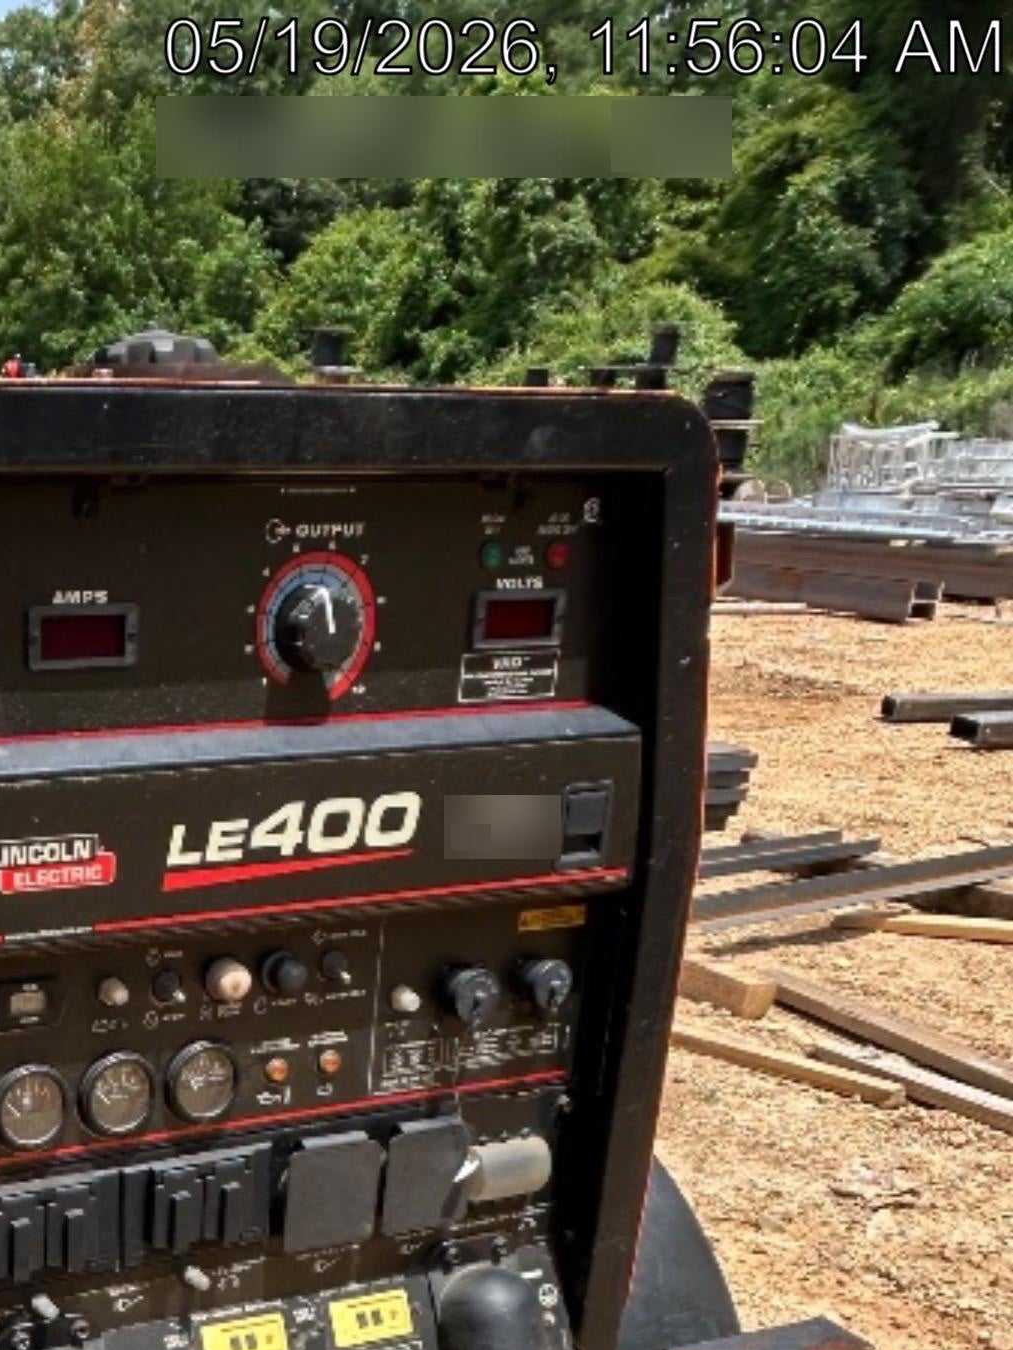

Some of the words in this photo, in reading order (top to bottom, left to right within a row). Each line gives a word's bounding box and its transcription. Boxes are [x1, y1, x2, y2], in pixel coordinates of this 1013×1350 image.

[295, 522, 366, 538] OUTPUT
[496, 575, 544, 590] VOLTS
[52, 589, 108, 604] AMPS
[166, 791, 422, 868] LE400
[13, 862, 103, 887] ELECTRIC
